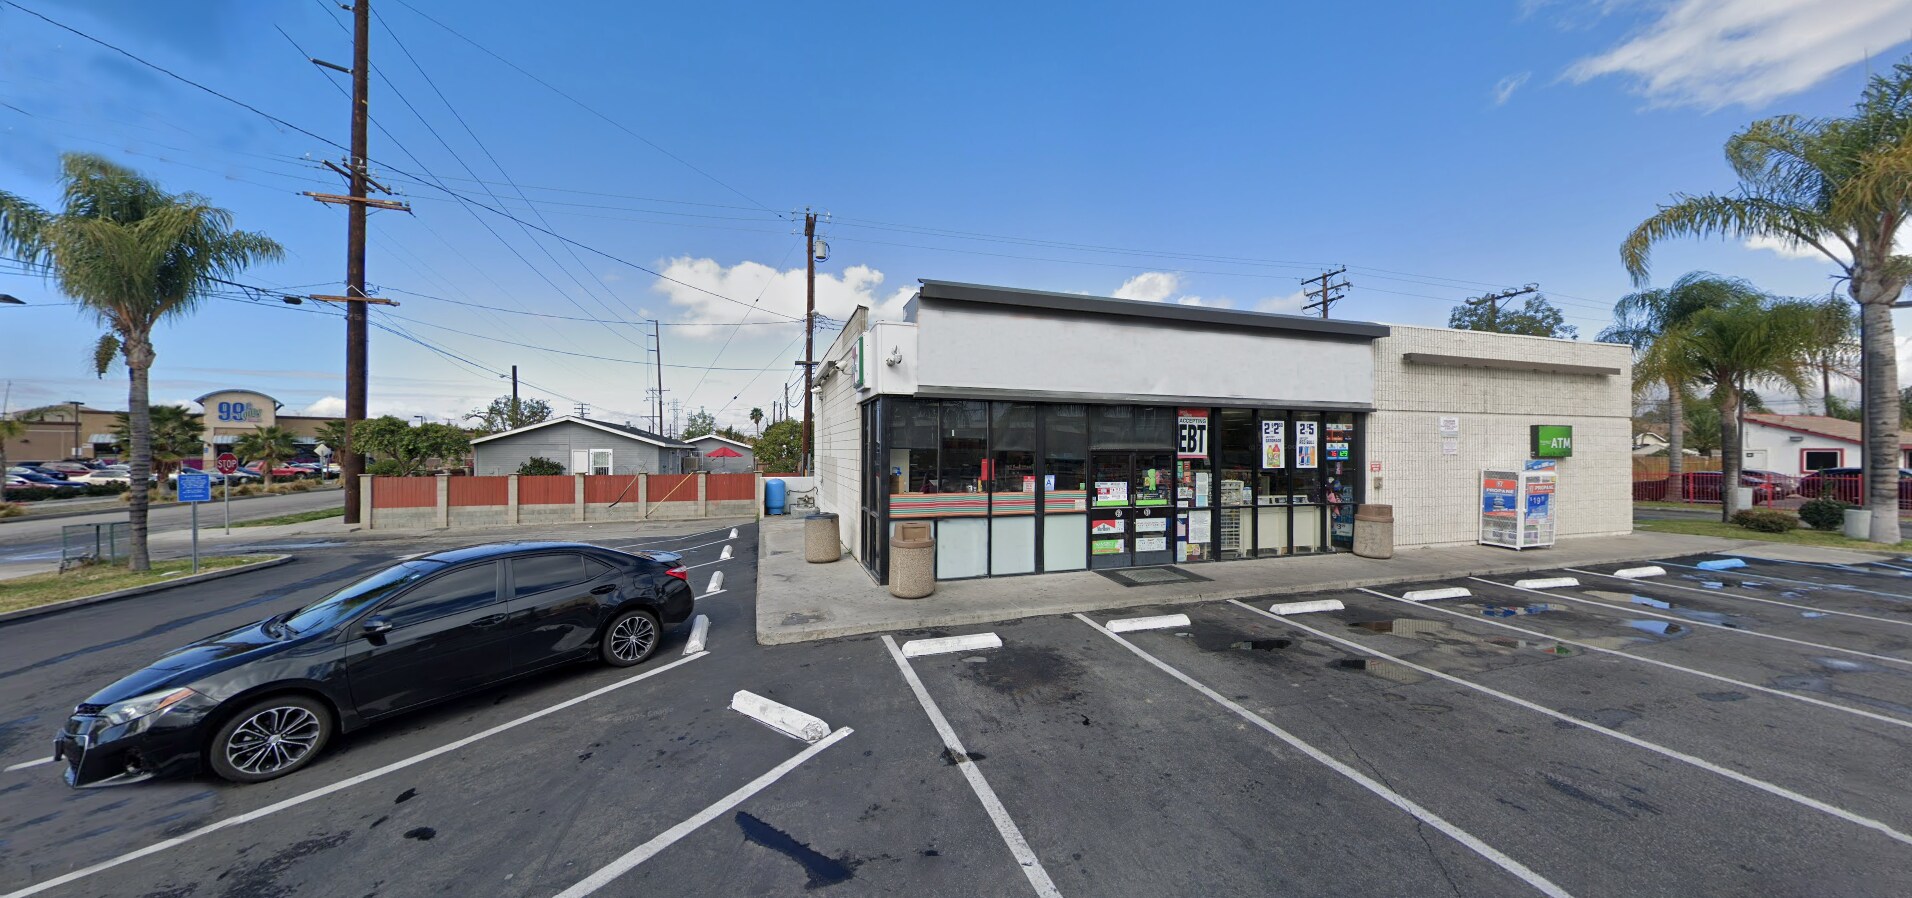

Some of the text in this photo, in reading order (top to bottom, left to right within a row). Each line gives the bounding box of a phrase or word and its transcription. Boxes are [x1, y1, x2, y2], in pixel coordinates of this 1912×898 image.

[1264, 423, 1270, 434] 2
[1300, 424, 1305, 434] 2
[1179, 424, 1206, 453] EBT
[1551, 438, 1571, 448] ATM
[218, 460, 236, 468] STOP
